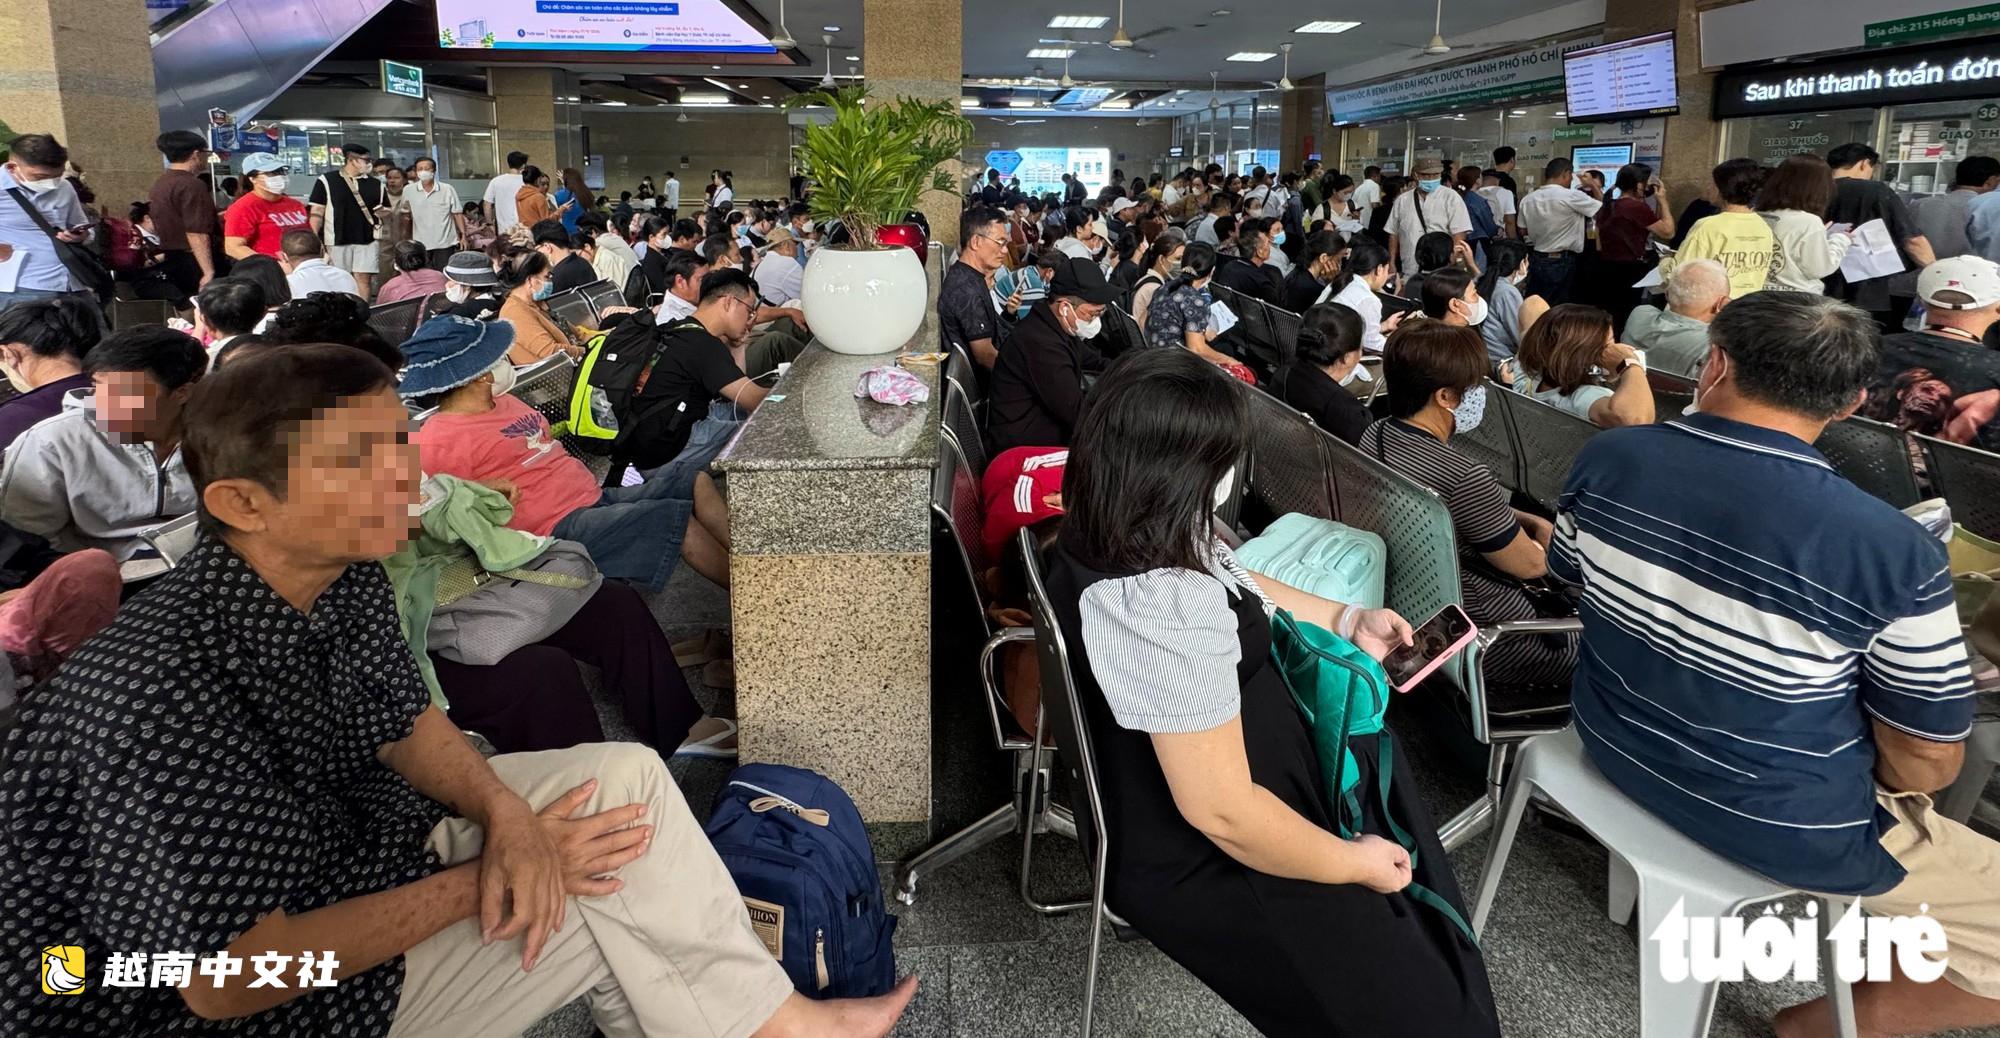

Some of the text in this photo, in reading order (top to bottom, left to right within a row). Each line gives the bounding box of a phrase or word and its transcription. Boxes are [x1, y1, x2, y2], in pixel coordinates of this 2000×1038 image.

[1868, 28, 1886, 38] Địa
[1909, 20, 1930, 32] 215
[1404, 79, 1417, 90] ĐẠI
[1417, 75, 1434, 88] HỌC
[1434, 73, 1440, 83] Y
[1440, 69, 1464, 82] DƯỢC
[1465, 62, 1497, 77] THÀNH
[1499, 56, 1520, 71] PHỐ
[1540, 46, 1559, 62] CHÍ
[1745, 56, 2000, 101] Sau khi thanh toán đơn
[1978, 107, 1999, 119] 38
[1788, 120, 1804, 130] 37
[1762, 132, 1829, 147] GIAO THUỐC
[1938, 129, 1975, 140] GIAO
